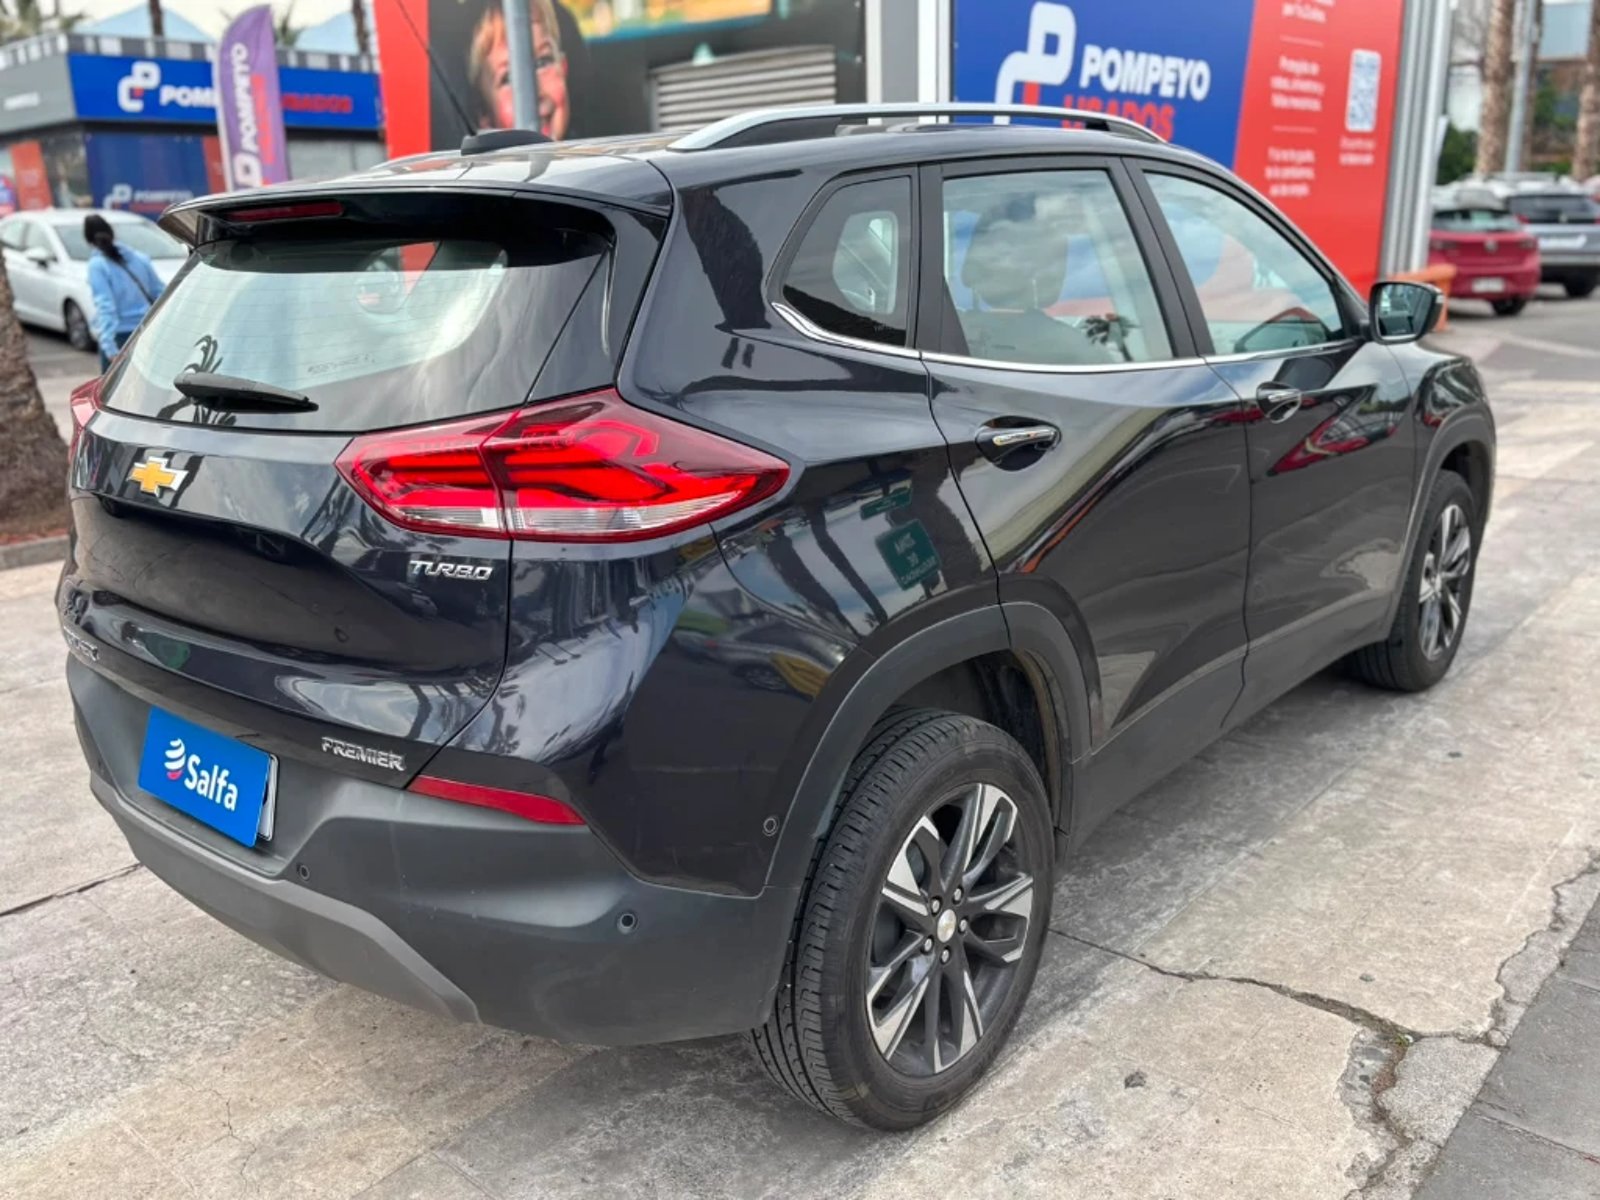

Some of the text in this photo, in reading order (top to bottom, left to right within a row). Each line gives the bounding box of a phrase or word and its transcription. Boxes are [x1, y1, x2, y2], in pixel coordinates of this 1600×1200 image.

[1079, 44, 1211, 102] POMPEYO
[410, 560, 493, 581] TURBO
[321, 736, 406, 772] PREMIER
[183, 752, 239, 811] Salfa
